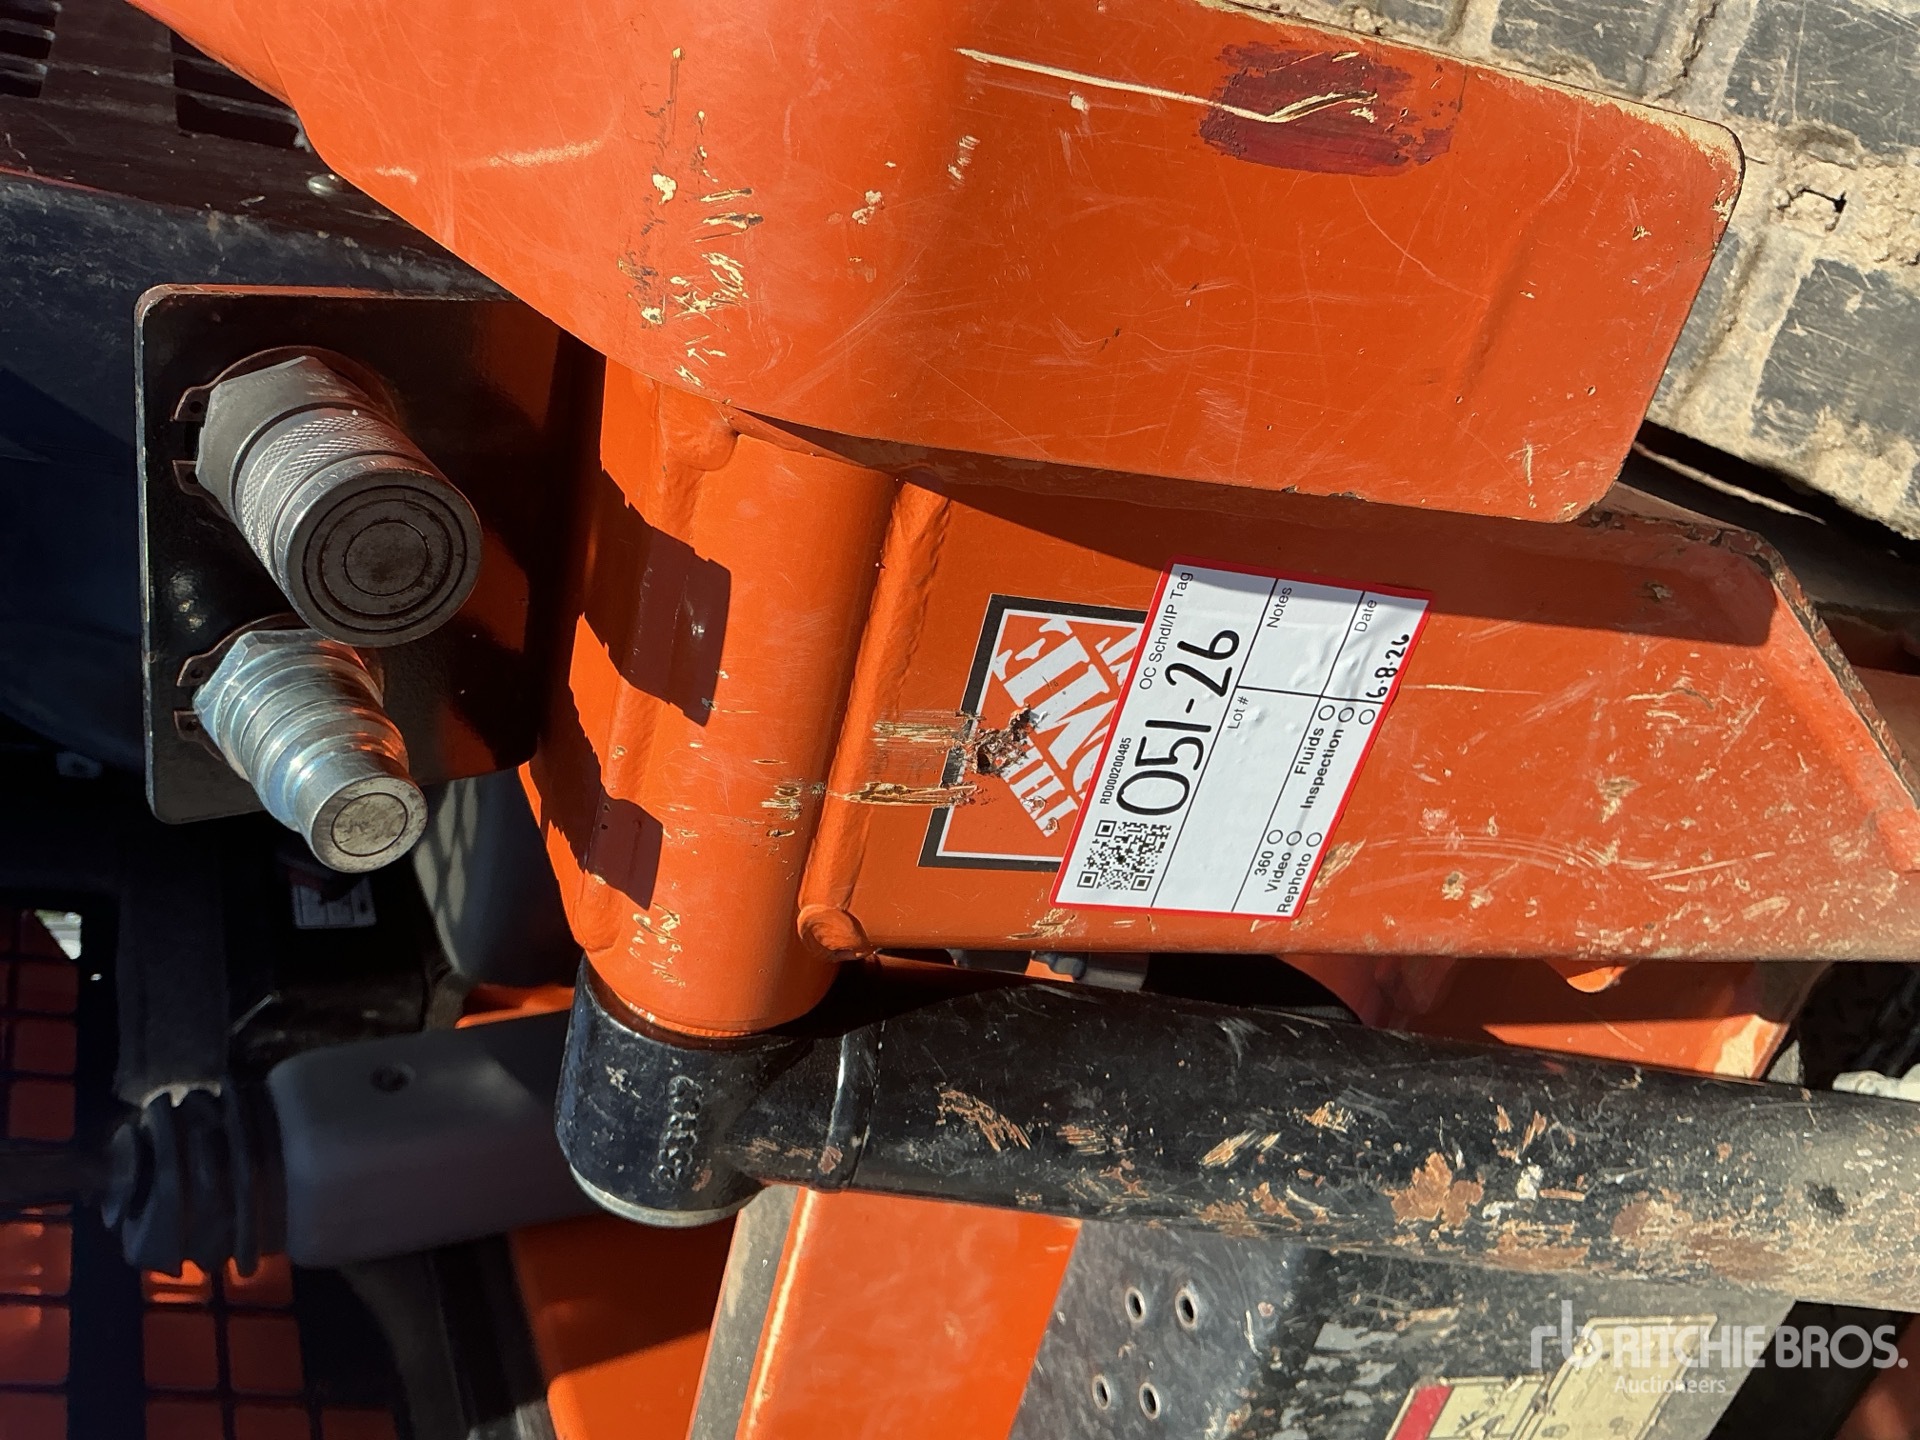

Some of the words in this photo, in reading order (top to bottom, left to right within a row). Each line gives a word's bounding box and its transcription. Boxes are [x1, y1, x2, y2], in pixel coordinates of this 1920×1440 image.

[1139, 667, 1157, 690] OC
[1148, 604, 1178, 663] Schdl/IP
[1169, 571, 1194, 600] Tag
[1266, 586, 1292, 629] Notes
[1354, 600, 1377, 633] Date
[993, 619, 1119, 800] ME
[1116, 630, 1240, 816] 051-26
[1227, 708, 1246, 730] Lot
[1237, 695, 1249, 706] #
[1099, 736, 1132, 805] RD000200485
[1294, 727, 1324, 775] Fluids
[1300, 728, 1344, 809] Inspection
[1254, 850, 1275, 876] 360
[1264, 852, 1292, 893] Video
[1276, 853, 1312, 913] Rephoto
